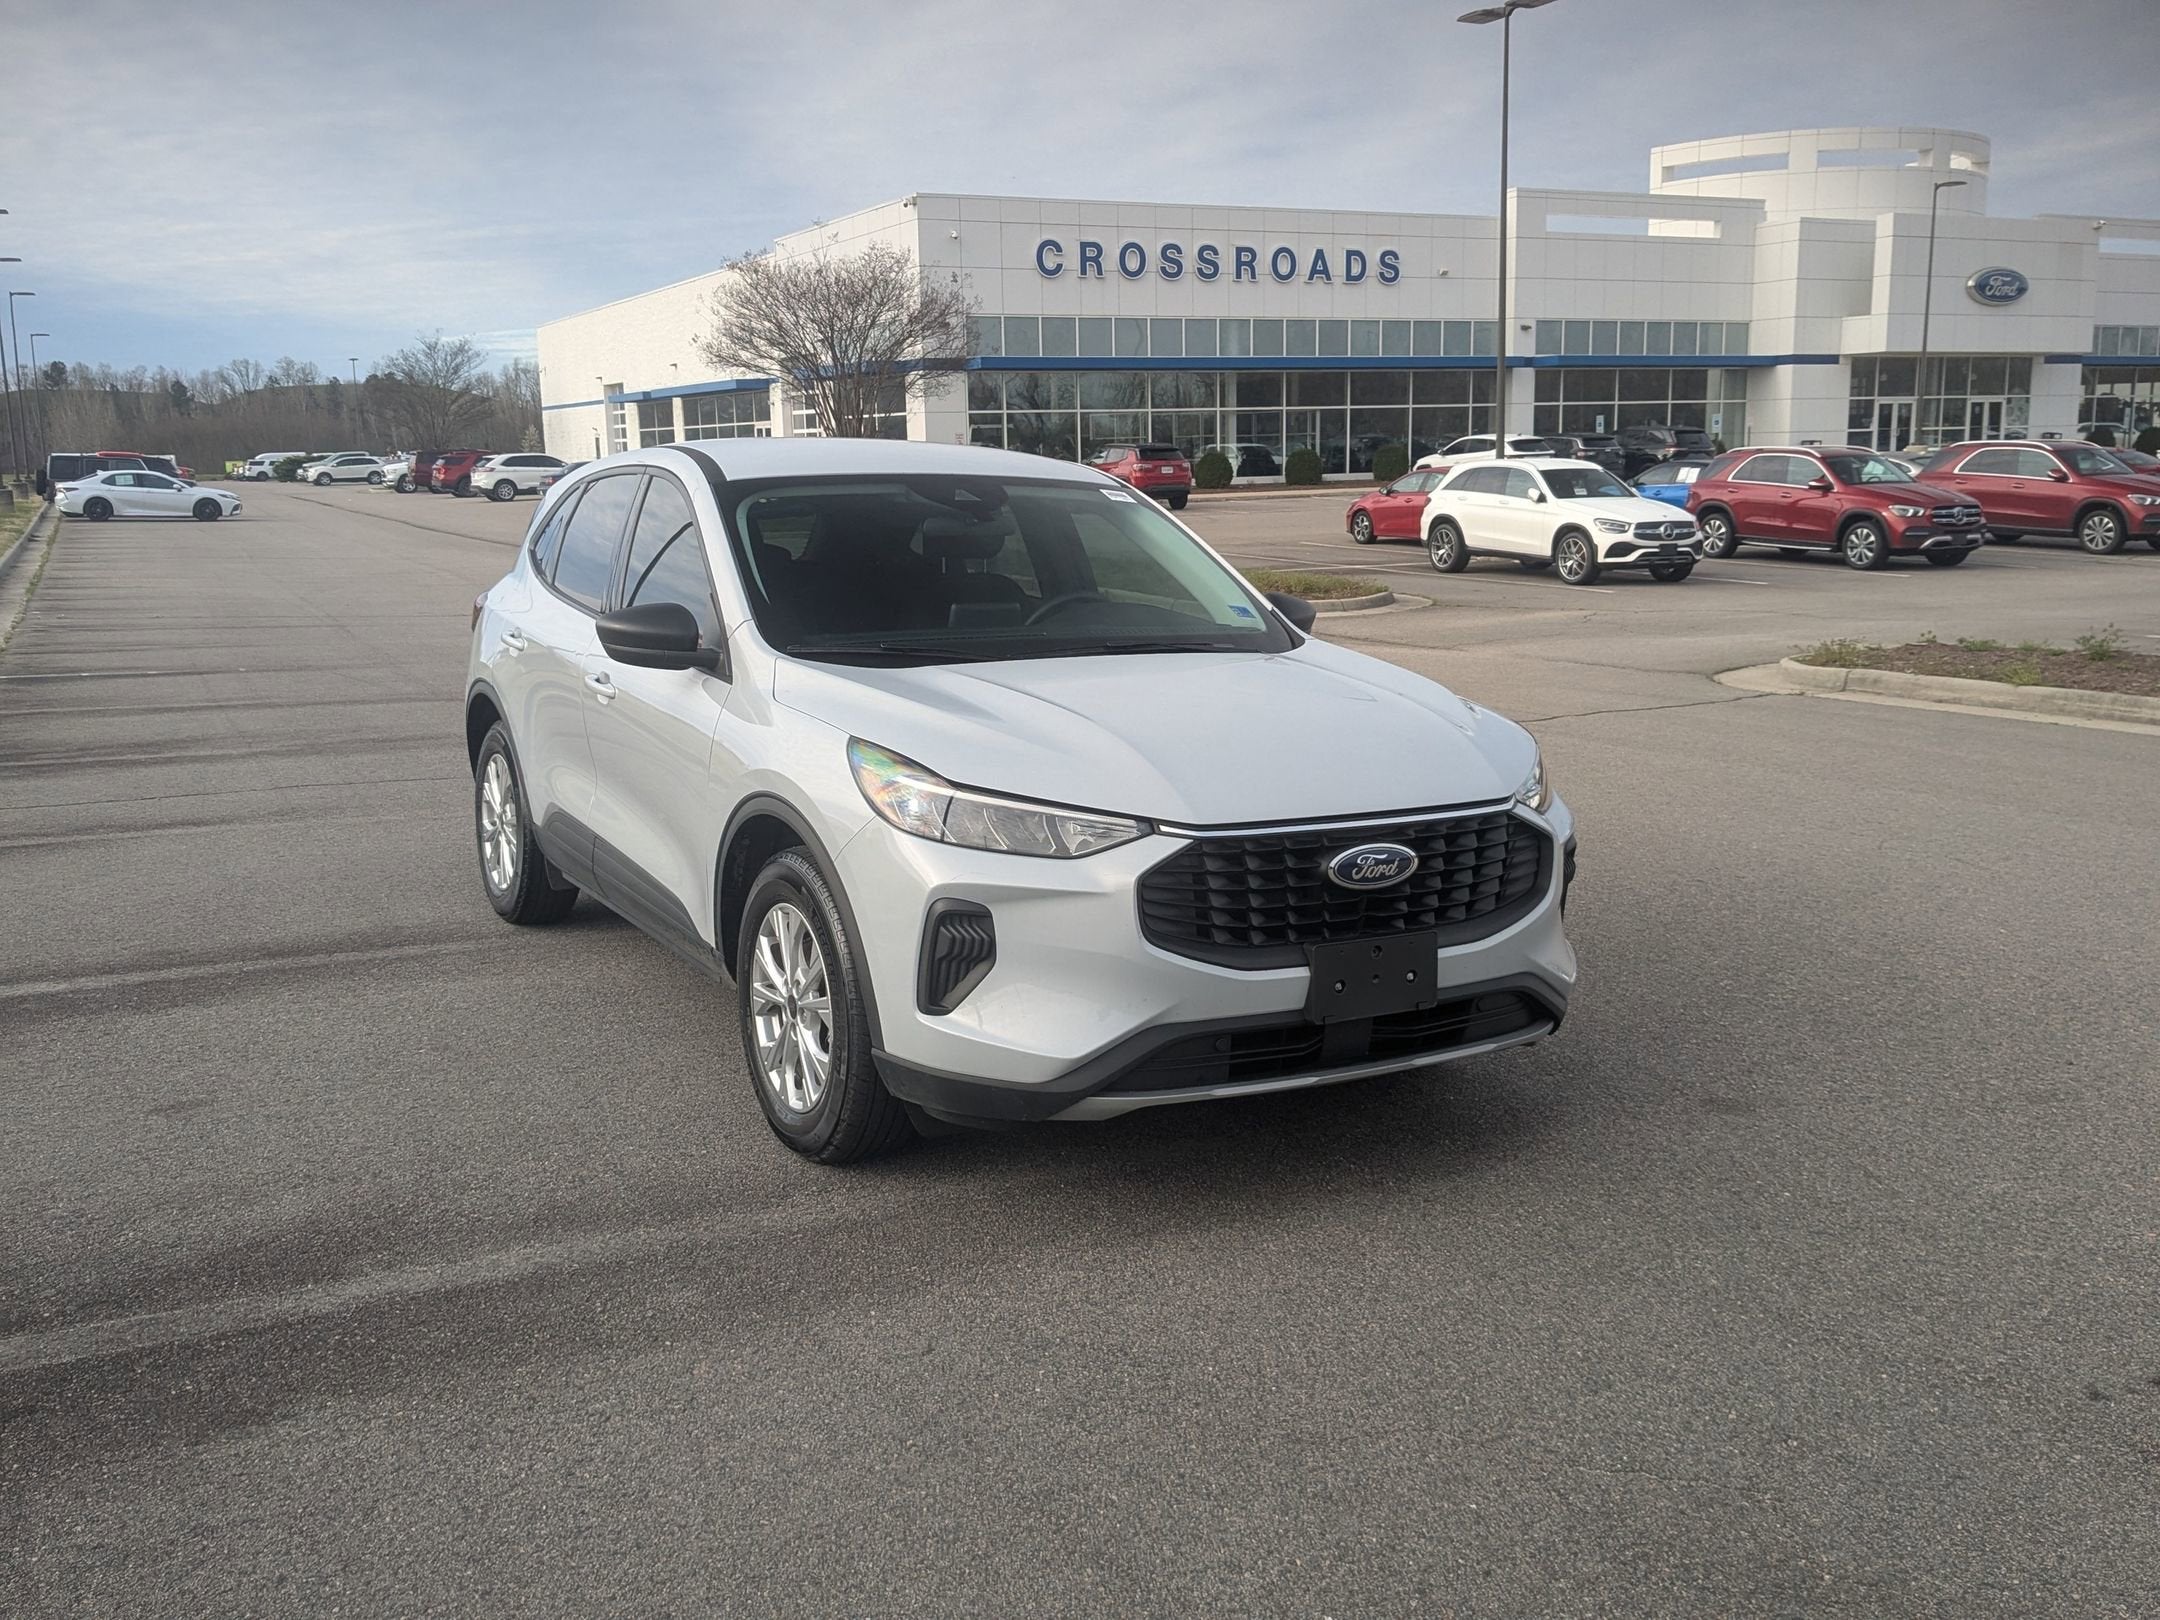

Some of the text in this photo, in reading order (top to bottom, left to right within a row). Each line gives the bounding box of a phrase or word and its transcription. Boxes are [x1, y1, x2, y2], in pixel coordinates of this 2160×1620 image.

[1035, 237, 1401, 285] CROSSROADS
[1985, 275, 2020, 297] Ford
[1351, 853, 1400, 880] Ford
